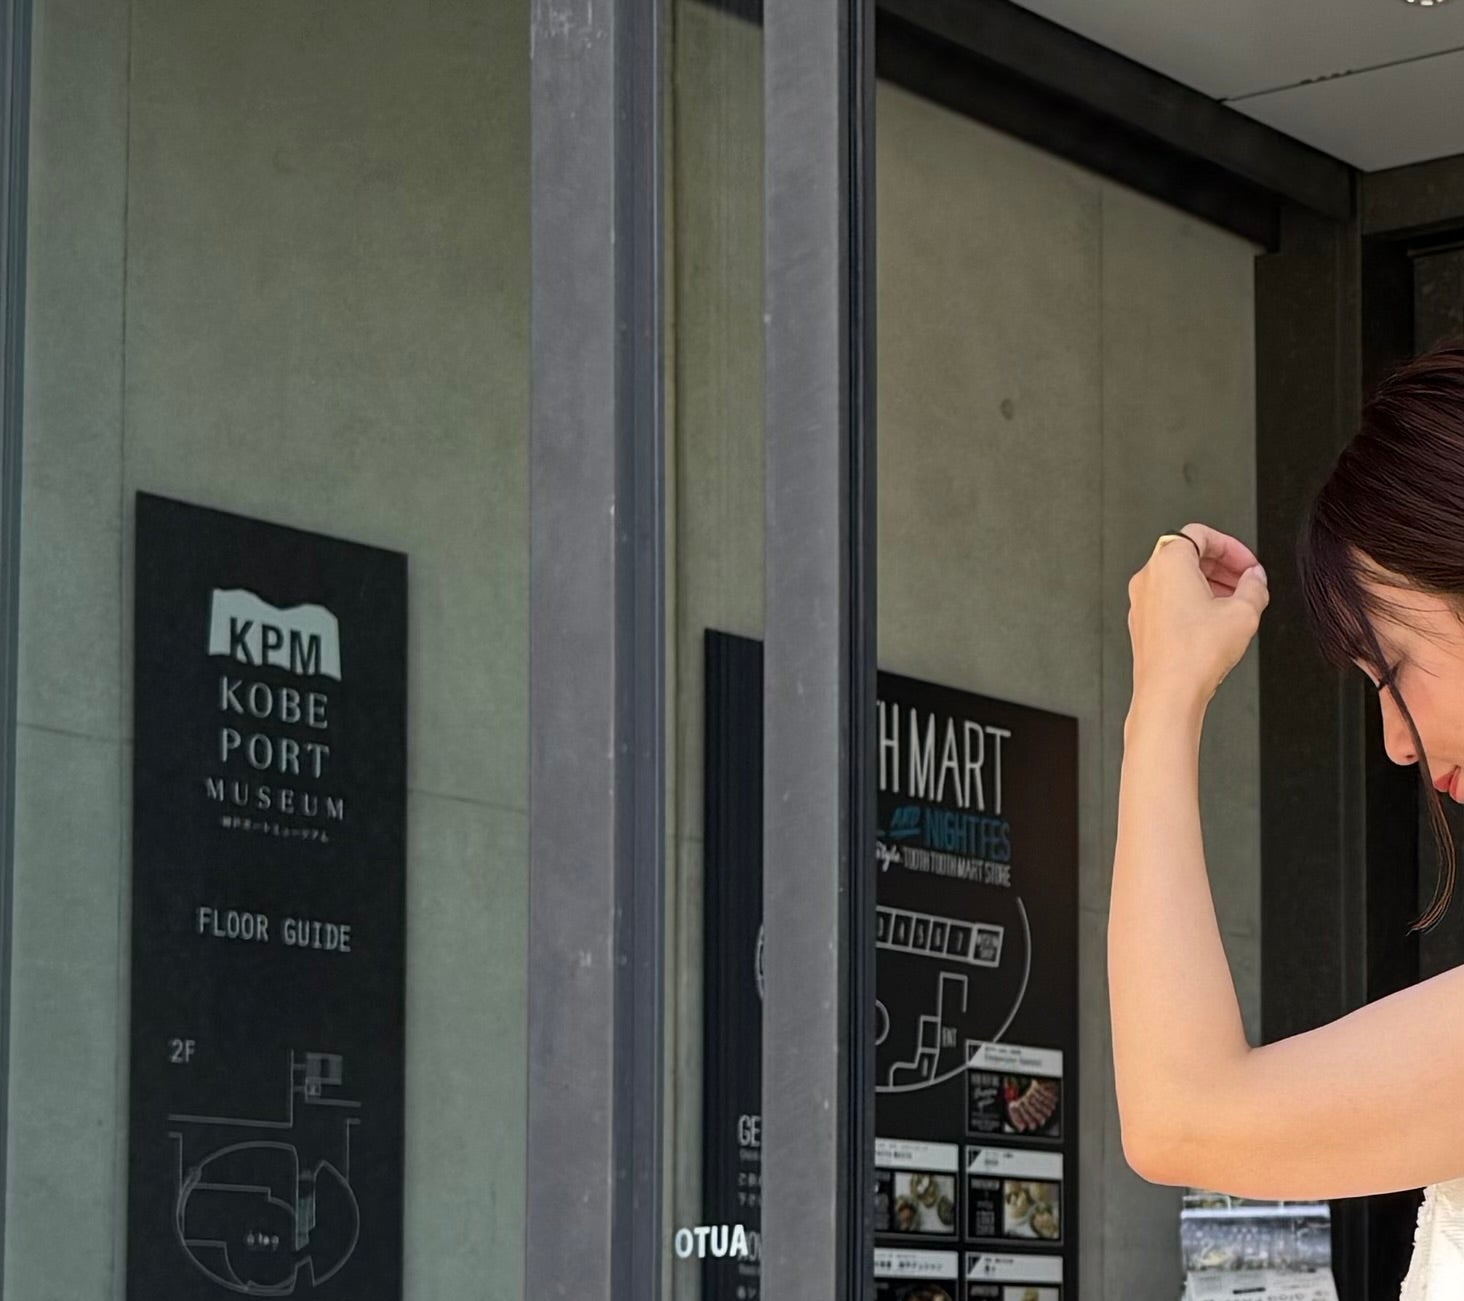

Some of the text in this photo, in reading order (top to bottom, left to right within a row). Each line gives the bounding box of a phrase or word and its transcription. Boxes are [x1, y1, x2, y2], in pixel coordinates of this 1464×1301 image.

[229, 616, 322, 675] KPM
[220, 676, 328, 729] KOBE
[221, 728, 330, 778] PORT
[908, 708, 1011, 814] MART
[206, 778, 344, 821] MUSEUM
[925, 808, 977, 855] NIGHT
[981, 816, 1011, 862] FES
[196, 906, 351, 952] FLOOR GUIDE
[170, 1040, 196, 1063] 2F
